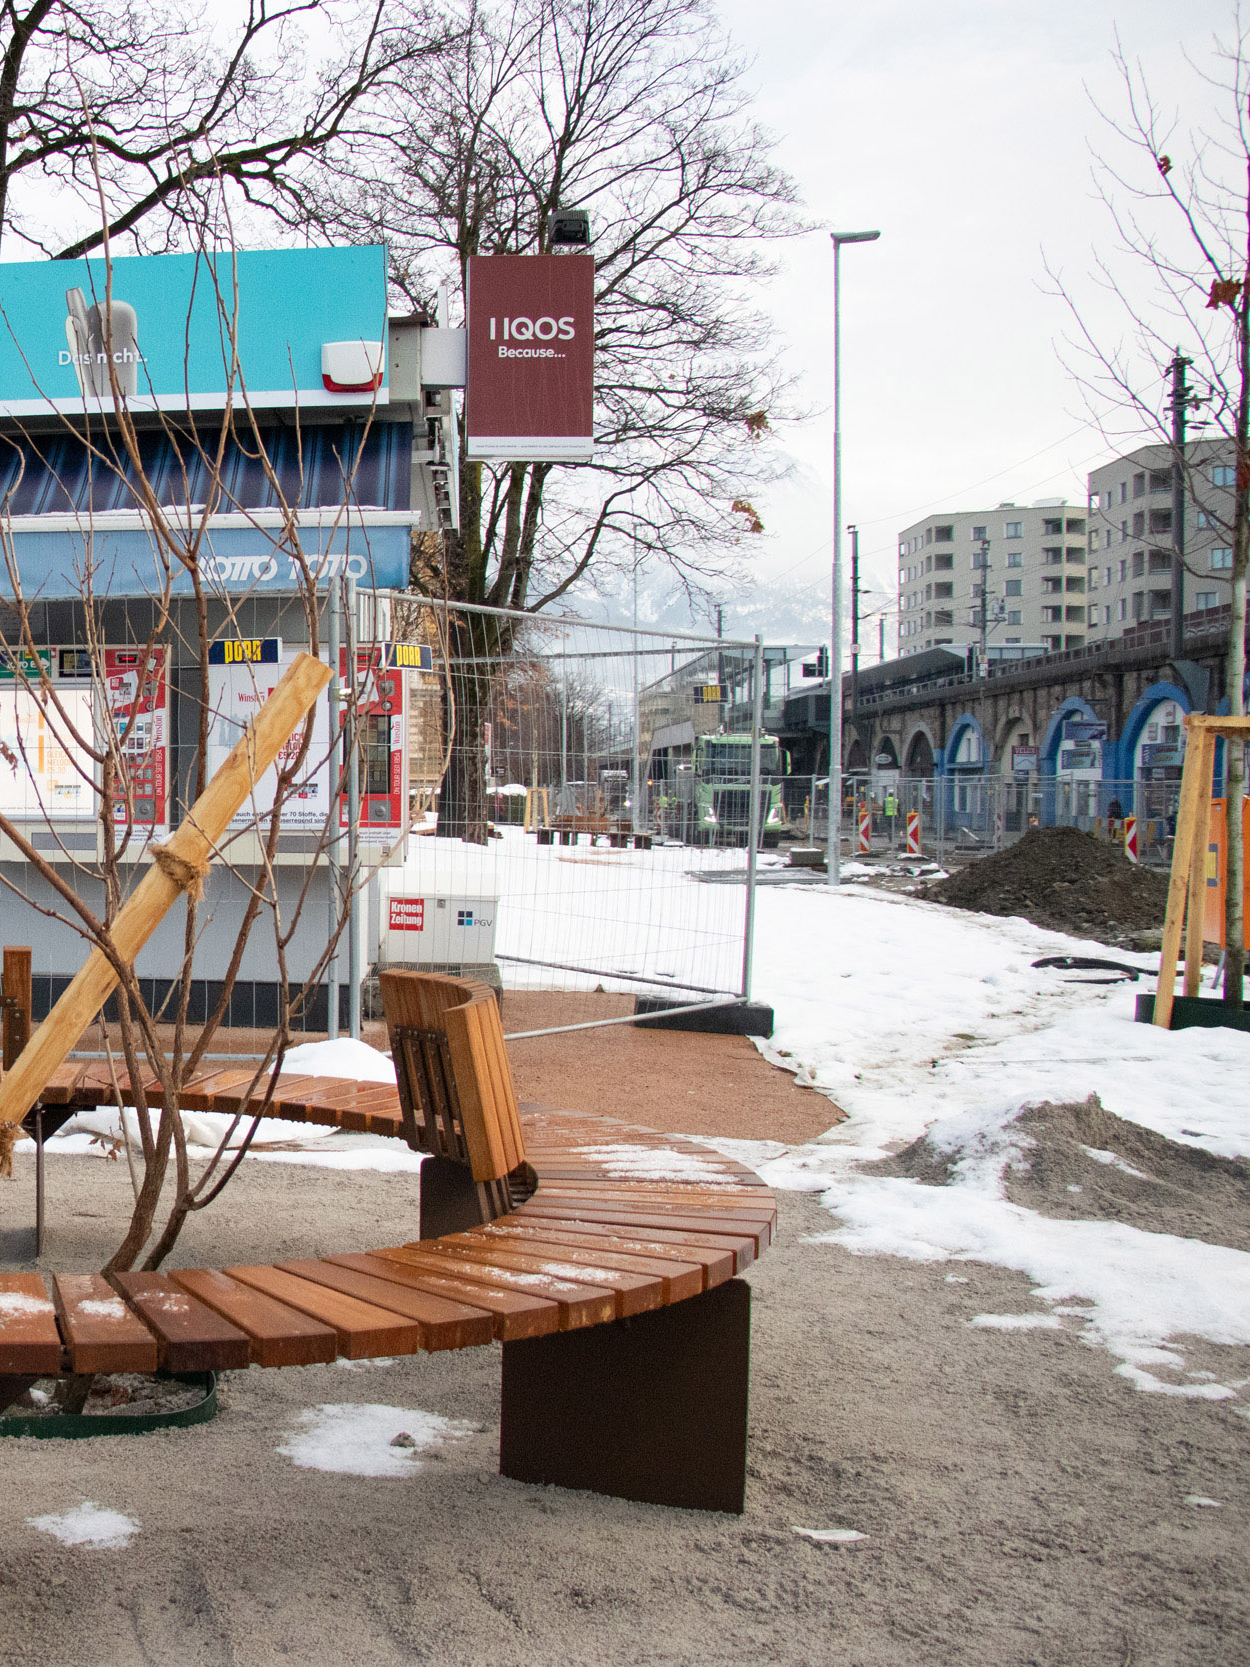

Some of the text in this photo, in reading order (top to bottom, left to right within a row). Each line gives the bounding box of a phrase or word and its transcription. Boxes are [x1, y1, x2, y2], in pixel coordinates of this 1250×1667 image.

[58, 347, 148, 366] Das ncht.
[498, 345, 566, 358] Because...
[197, 555, 279, 582] LOTTO
[287, 553, 368, 580] TOTO
[224, 640, 262, 663] PORR
[396, 644, 422, 667] PORR
[298, 811, 318, 819] Stoffe,
[391, 901, 423, 914] Kronen
[390, 913, 423, 926] Zeitung
[474, 919, 493, 927] PGV
